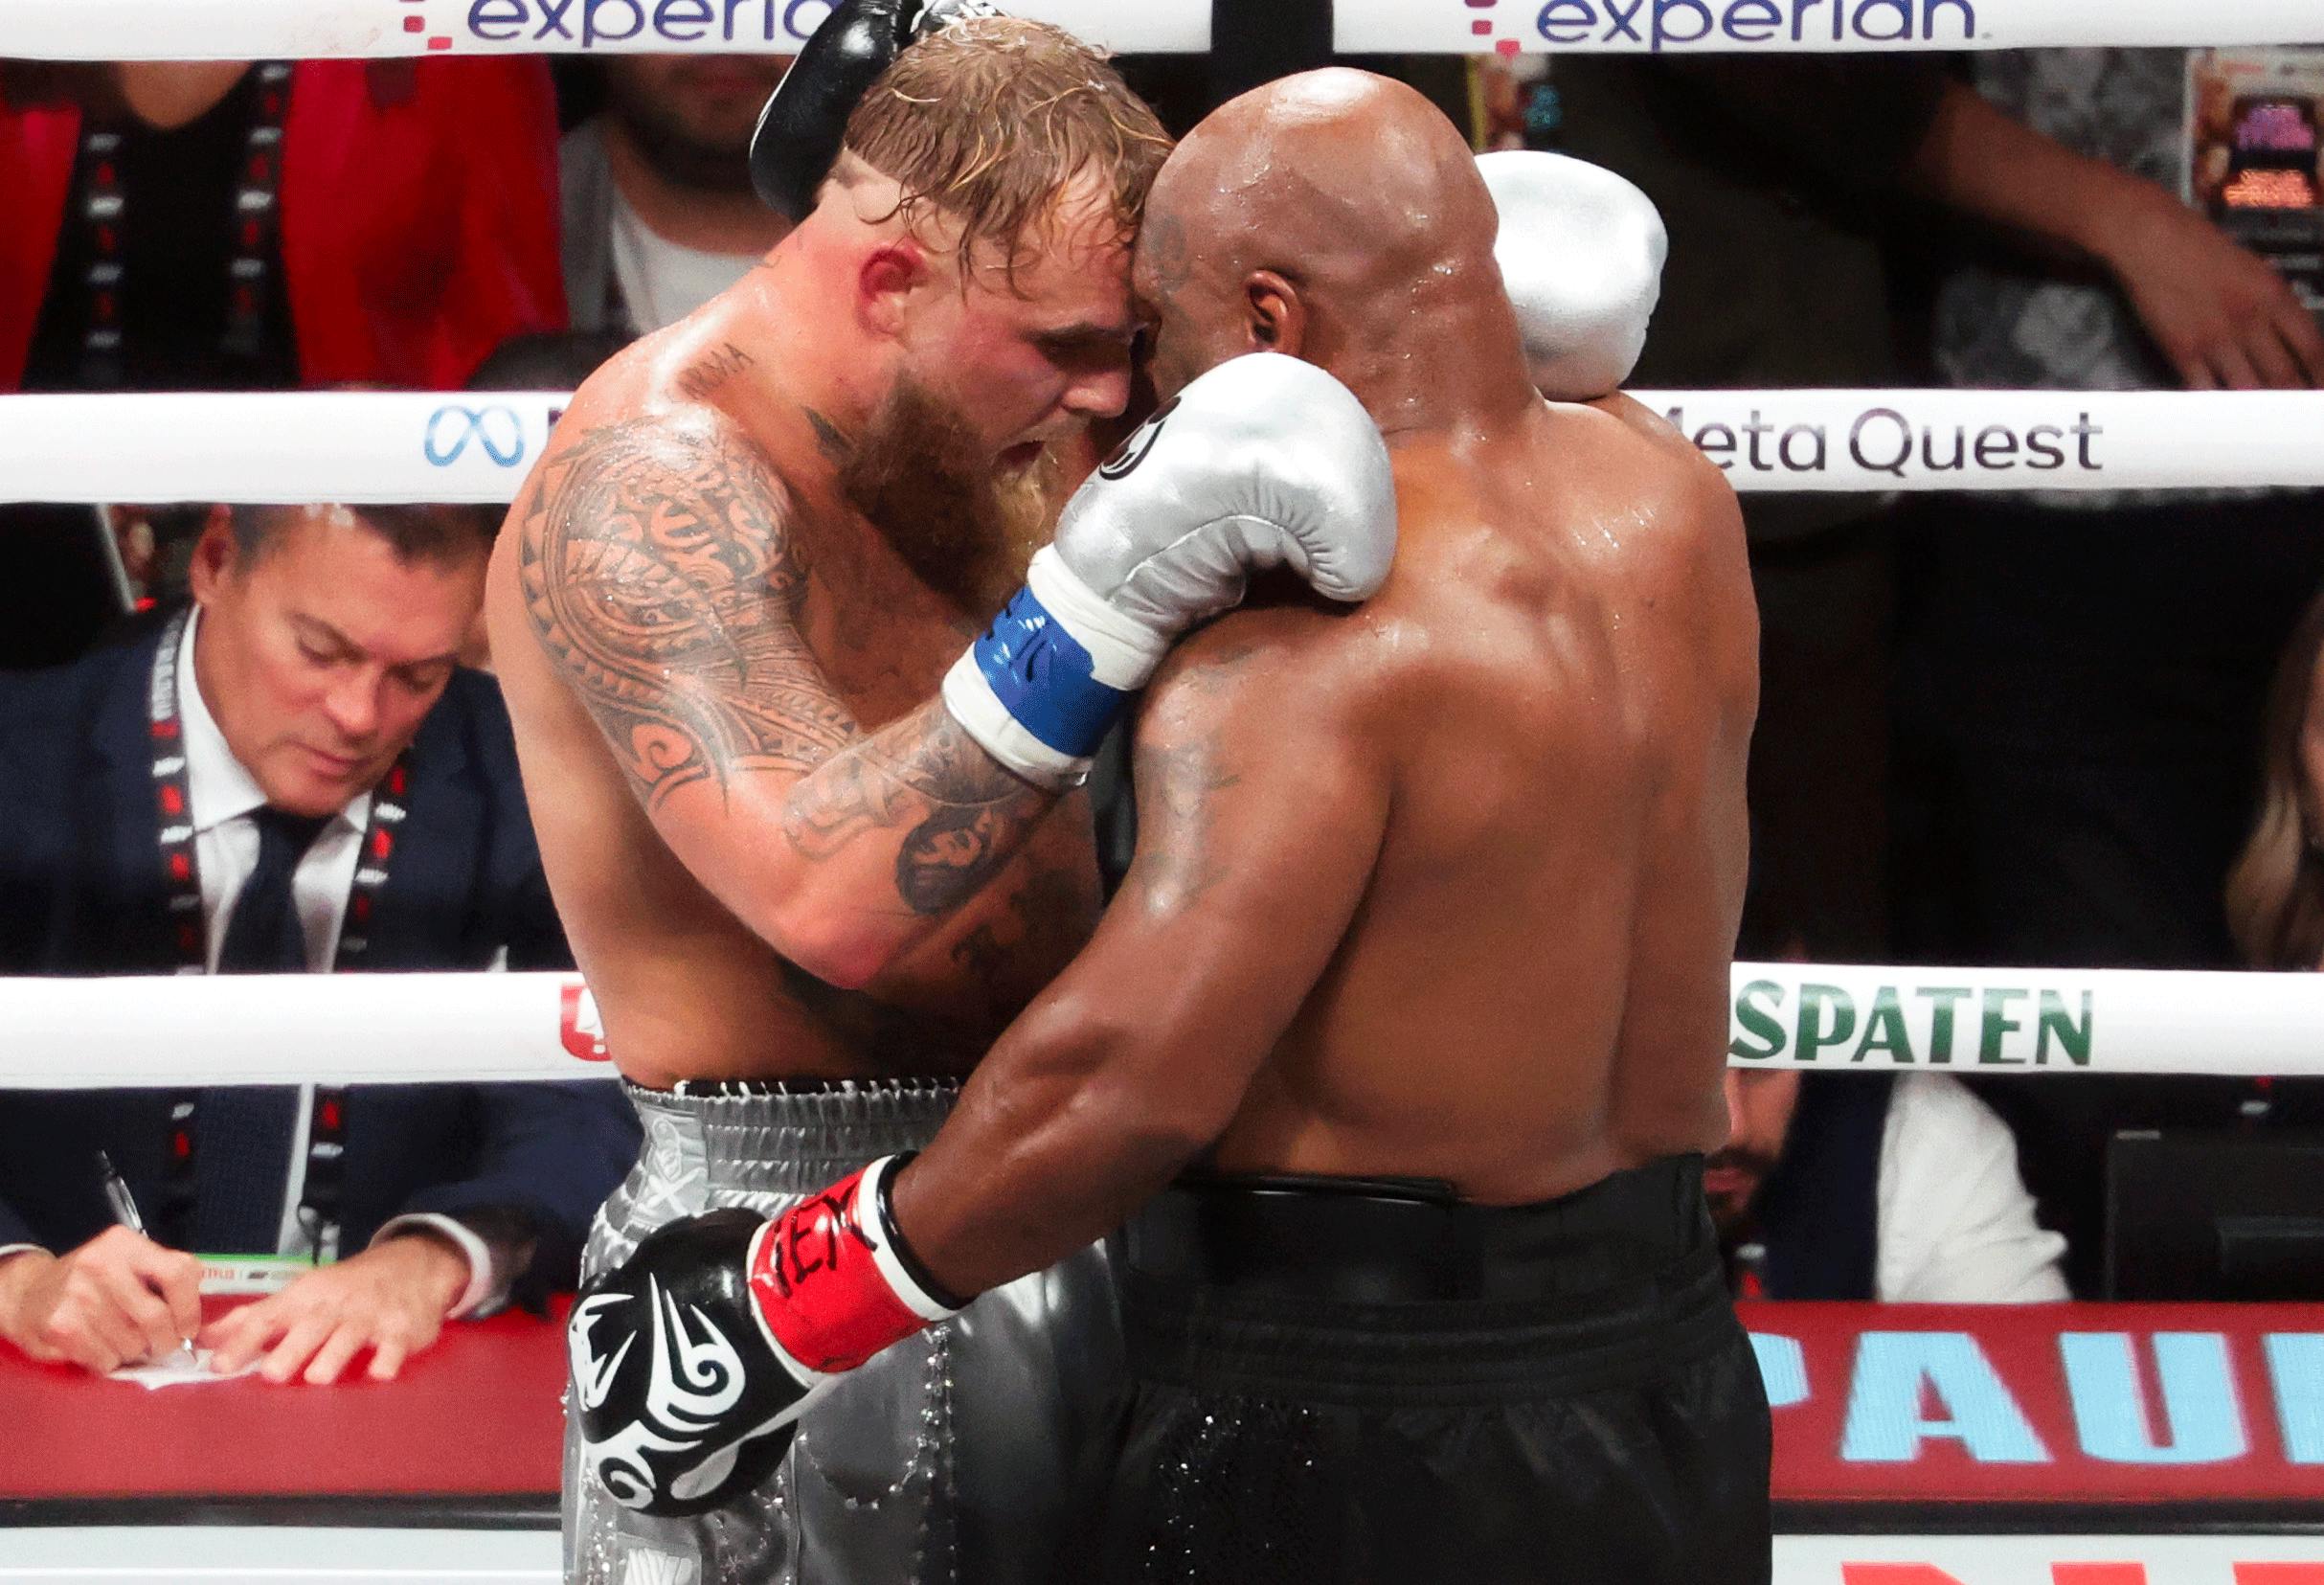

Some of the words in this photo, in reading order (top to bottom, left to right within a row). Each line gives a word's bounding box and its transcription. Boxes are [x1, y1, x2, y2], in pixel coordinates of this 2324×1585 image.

[1536, 0, 1975, 52] experian
[1664, 406, 1826, 471] eta
[1849, 407, 2104, 477] Quest
[1729, 980, 2093, 1066] SPATEN
